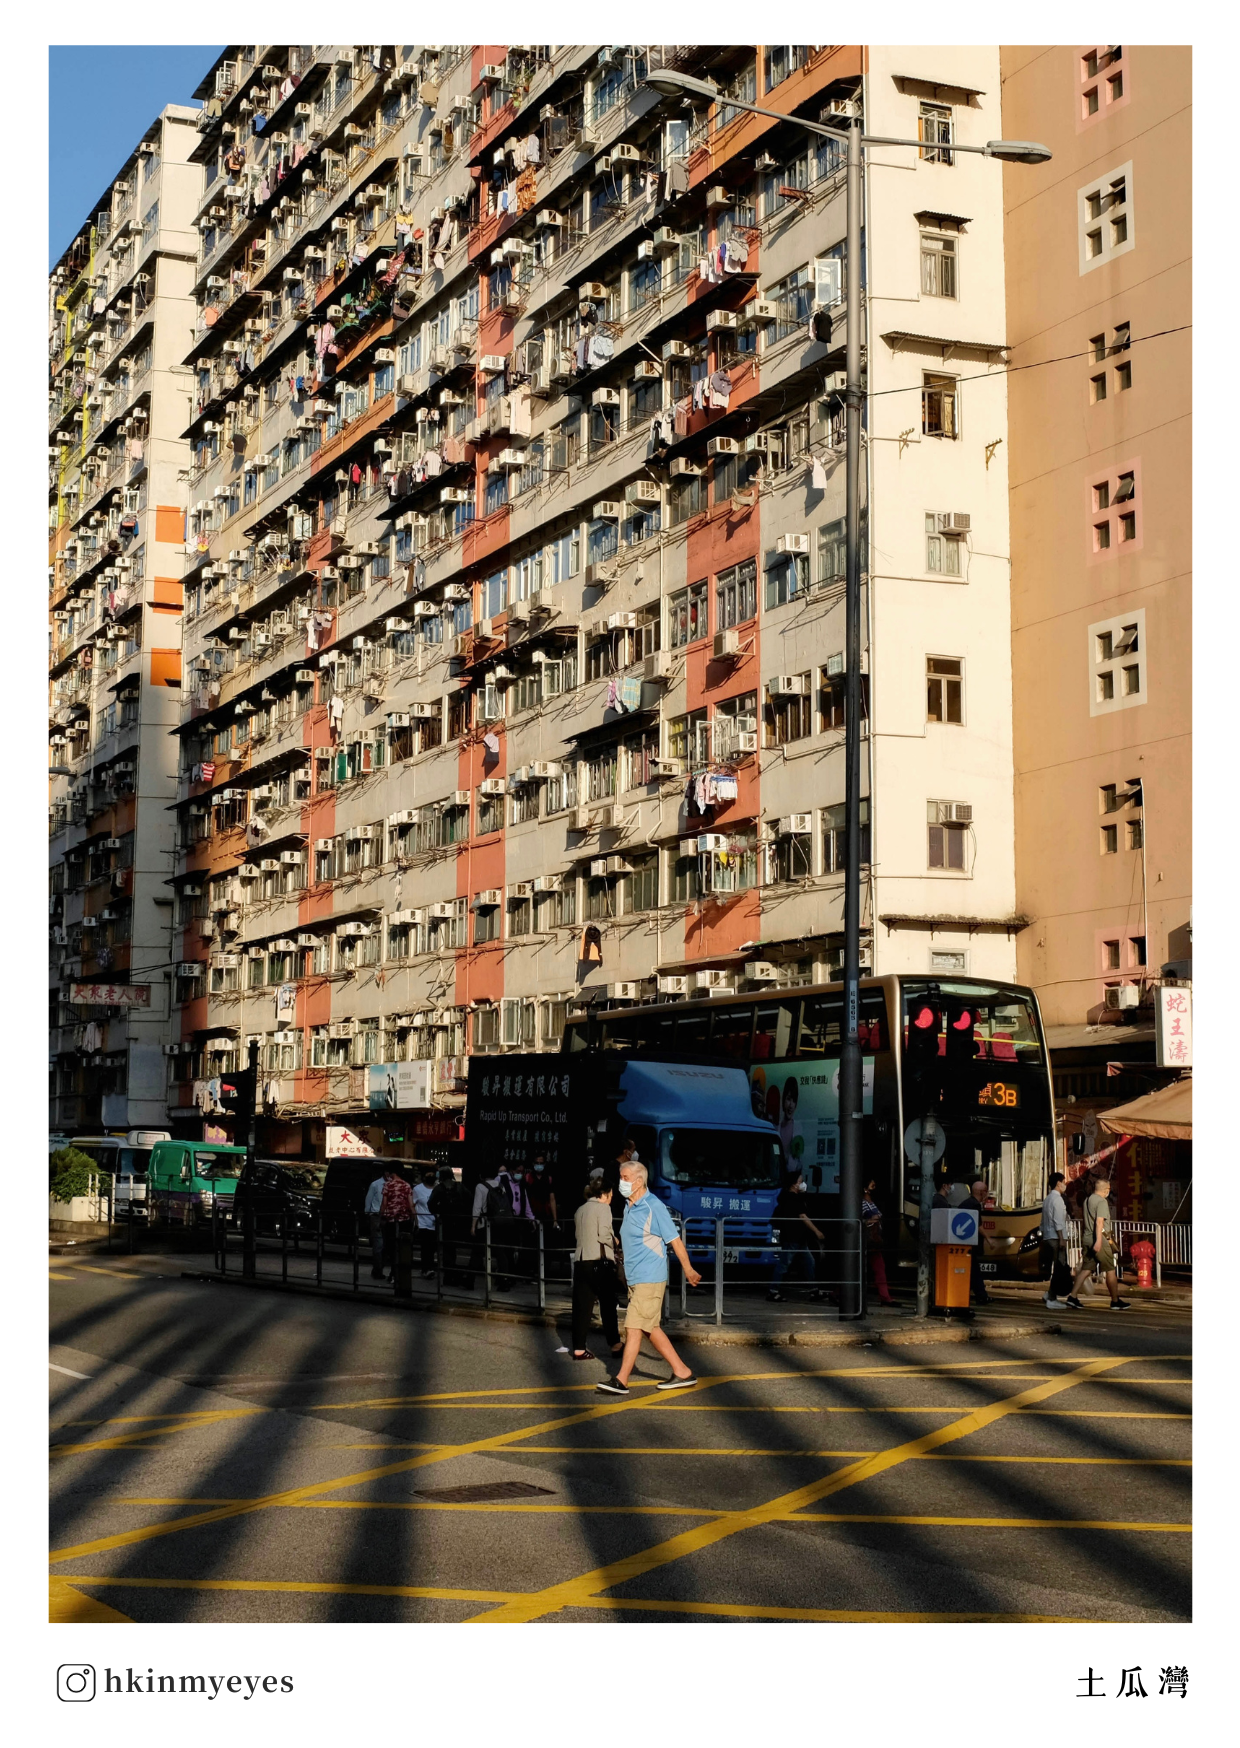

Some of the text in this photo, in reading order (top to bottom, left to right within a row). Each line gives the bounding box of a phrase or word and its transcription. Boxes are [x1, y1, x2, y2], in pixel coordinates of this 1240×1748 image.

[1166, 993, 1188, 1063] 蛇王濤
[667, 1069, 724, 1079] ISUZU
[994, 1082, 1017, 1106] 3B
[480, 1110, 497, 1123] Rapid
[498, 1110, 507, 1124] Up
[508, 1110, 539, 1124] Transport
[555, 1112, 568, 1123] Ltd.
[700, 1196, 751, 1211] 駿昇 搬運
